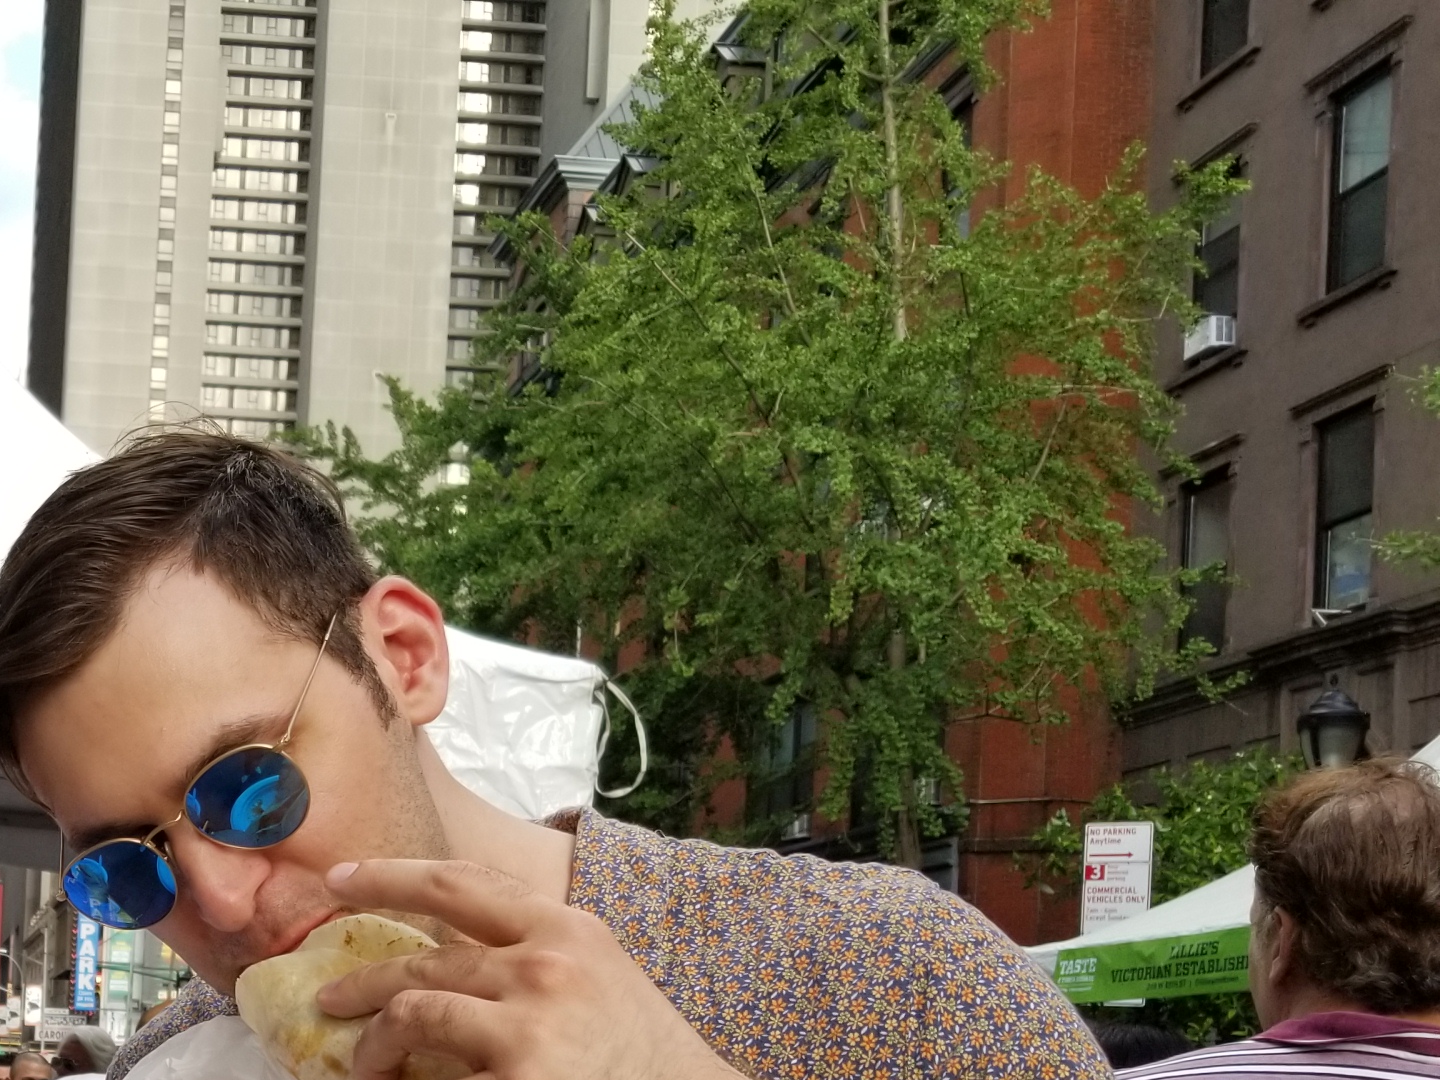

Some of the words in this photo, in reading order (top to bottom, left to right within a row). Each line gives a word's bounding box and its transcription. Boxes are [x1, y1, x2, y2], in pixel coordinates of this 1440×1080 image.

[1090, 828, 1101, 836] NO
[1103, 827, 1137, 835] PARKING
[1090, 837, 1121, 847] Anytime
[1087, 886, 1137, 895] COMMERCIAL
[1086, 896, 1123, 904] VEHICLES
[1125, 896, 1146, 904] ONLY
[79, 923, 97, 990] PARK
[1169, 940, 1220, 960] LILLIE'S
[1060, 957, 1098, 975] TASTE
[1110, 962, 1172, 983] VICTORIAN
